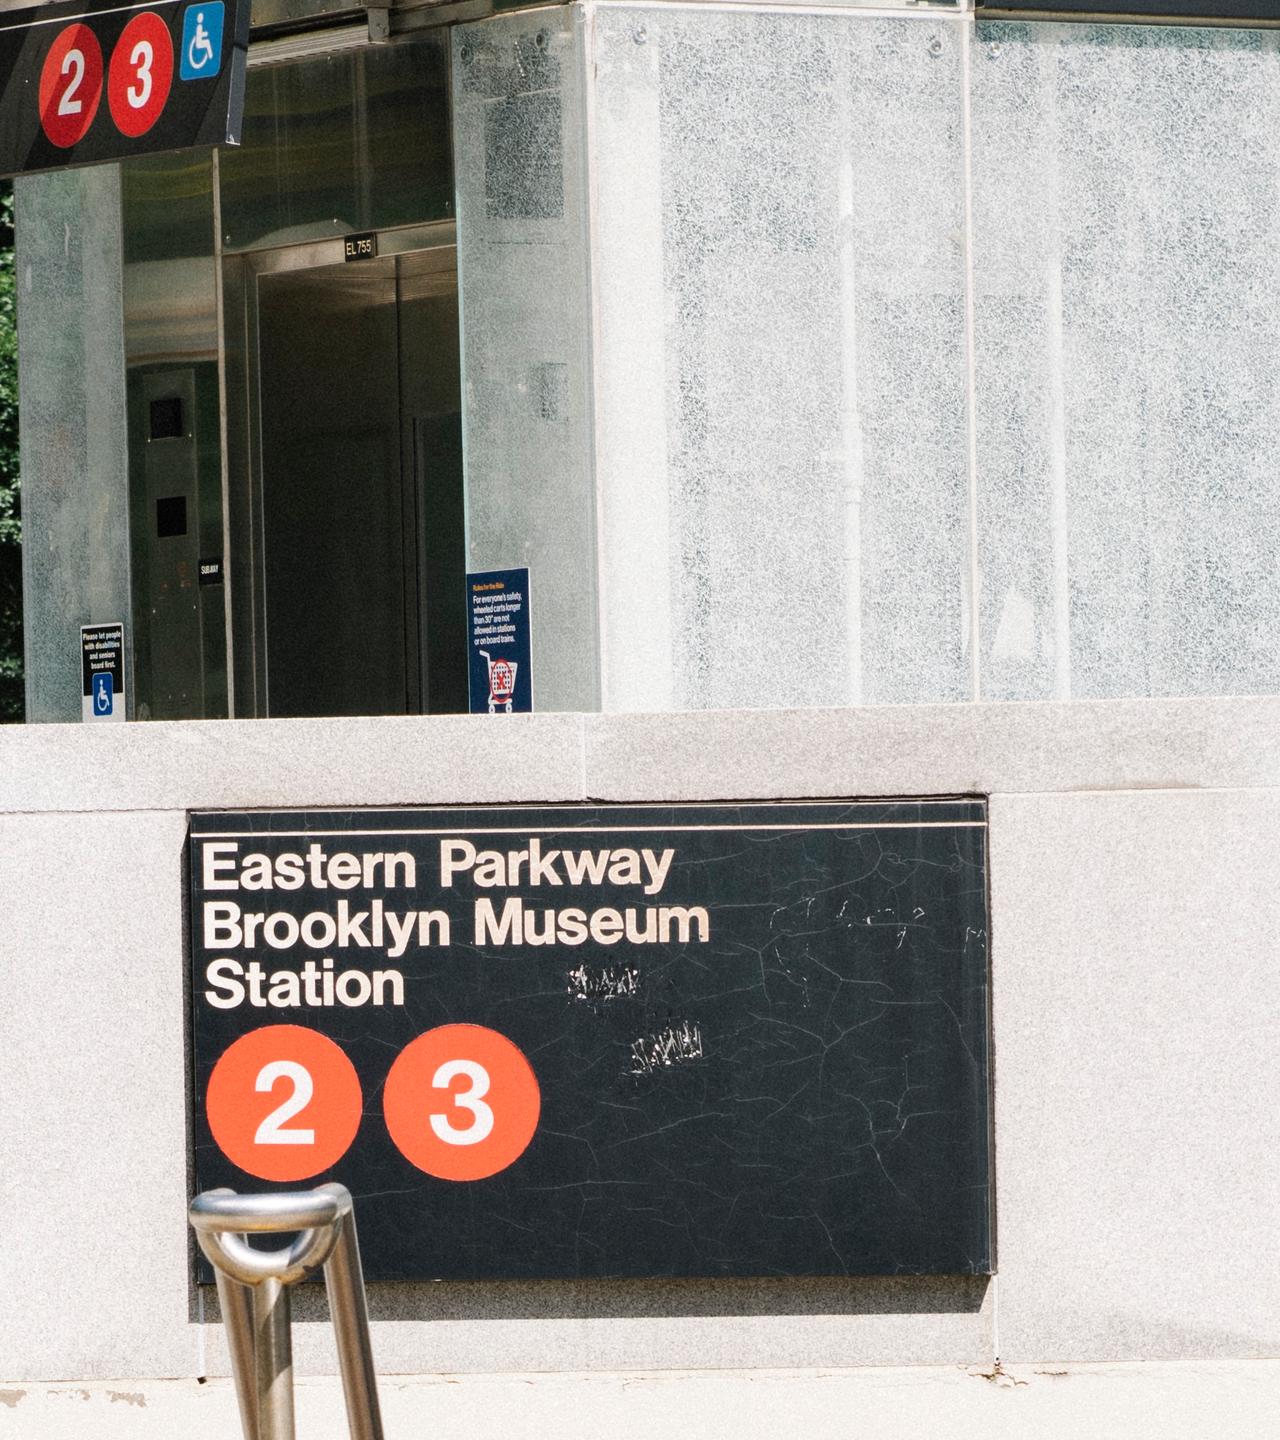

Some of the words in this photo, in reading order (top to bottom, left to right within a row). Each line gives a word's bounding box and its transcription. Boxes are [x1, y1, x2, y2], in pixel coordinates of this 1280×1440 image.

[57, 49, 85, 116] 2
[127, 40, 154, 108] 3
[346, 242, 357, 256] EL
[357, 239, 372, 253] 755
[201, 842, 416, 890] Eastern
[440, 837, 676, 896] Parkway
[203, 898, 450, 957] Brooklyn
[475, 897, 710, 946] Museum
[204, 958, 405, 1010] Station
[254, 1060, 315, 1145] 2
[429, 1059, 495, 1146] 3
